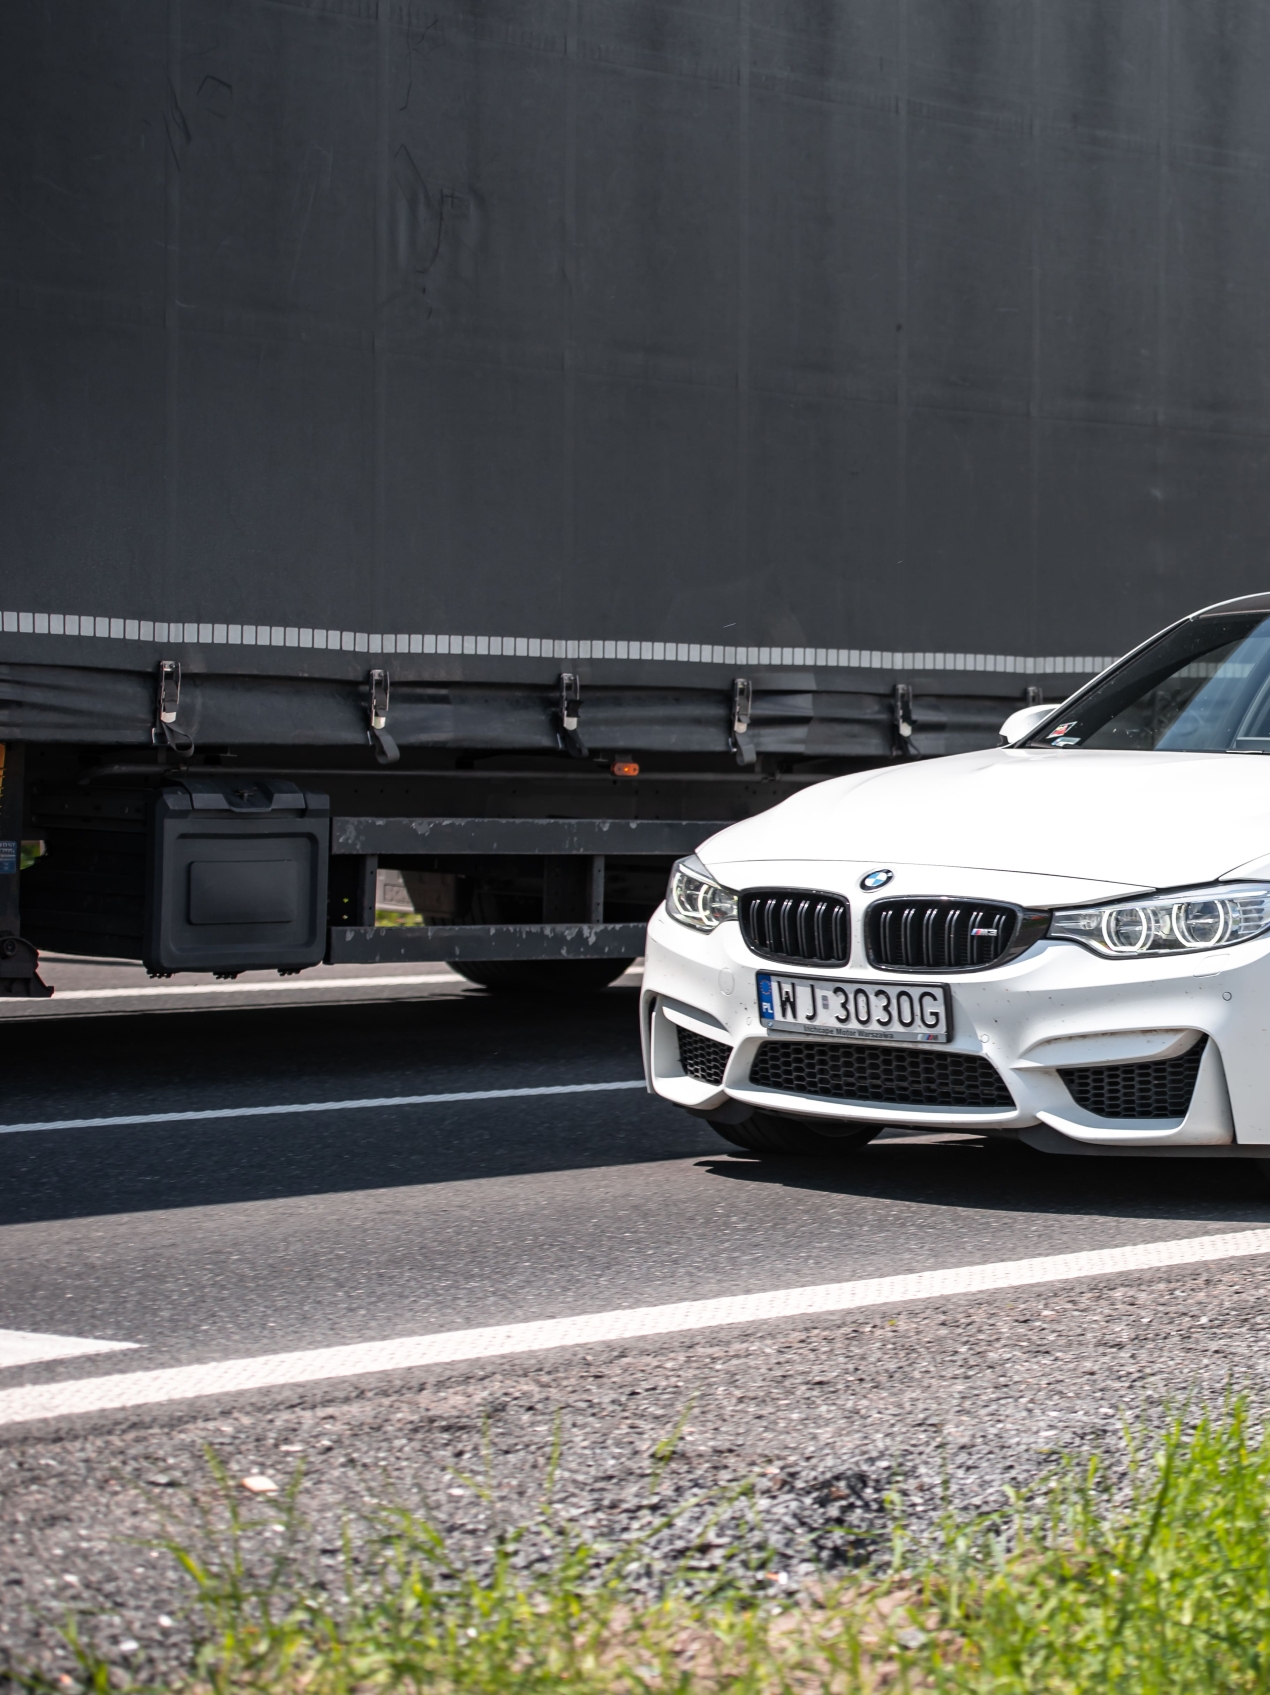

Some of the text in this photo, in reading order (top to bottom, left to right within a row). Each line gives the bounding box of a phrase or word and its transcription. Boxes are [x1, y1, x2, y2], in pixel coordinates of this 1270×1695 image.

[762, 1002, 774, 1014] PL
[777, 981, 940, 1028] WJ 3030G
[803, 1024, 895, 1039] Inchcape Motor Warszawa
